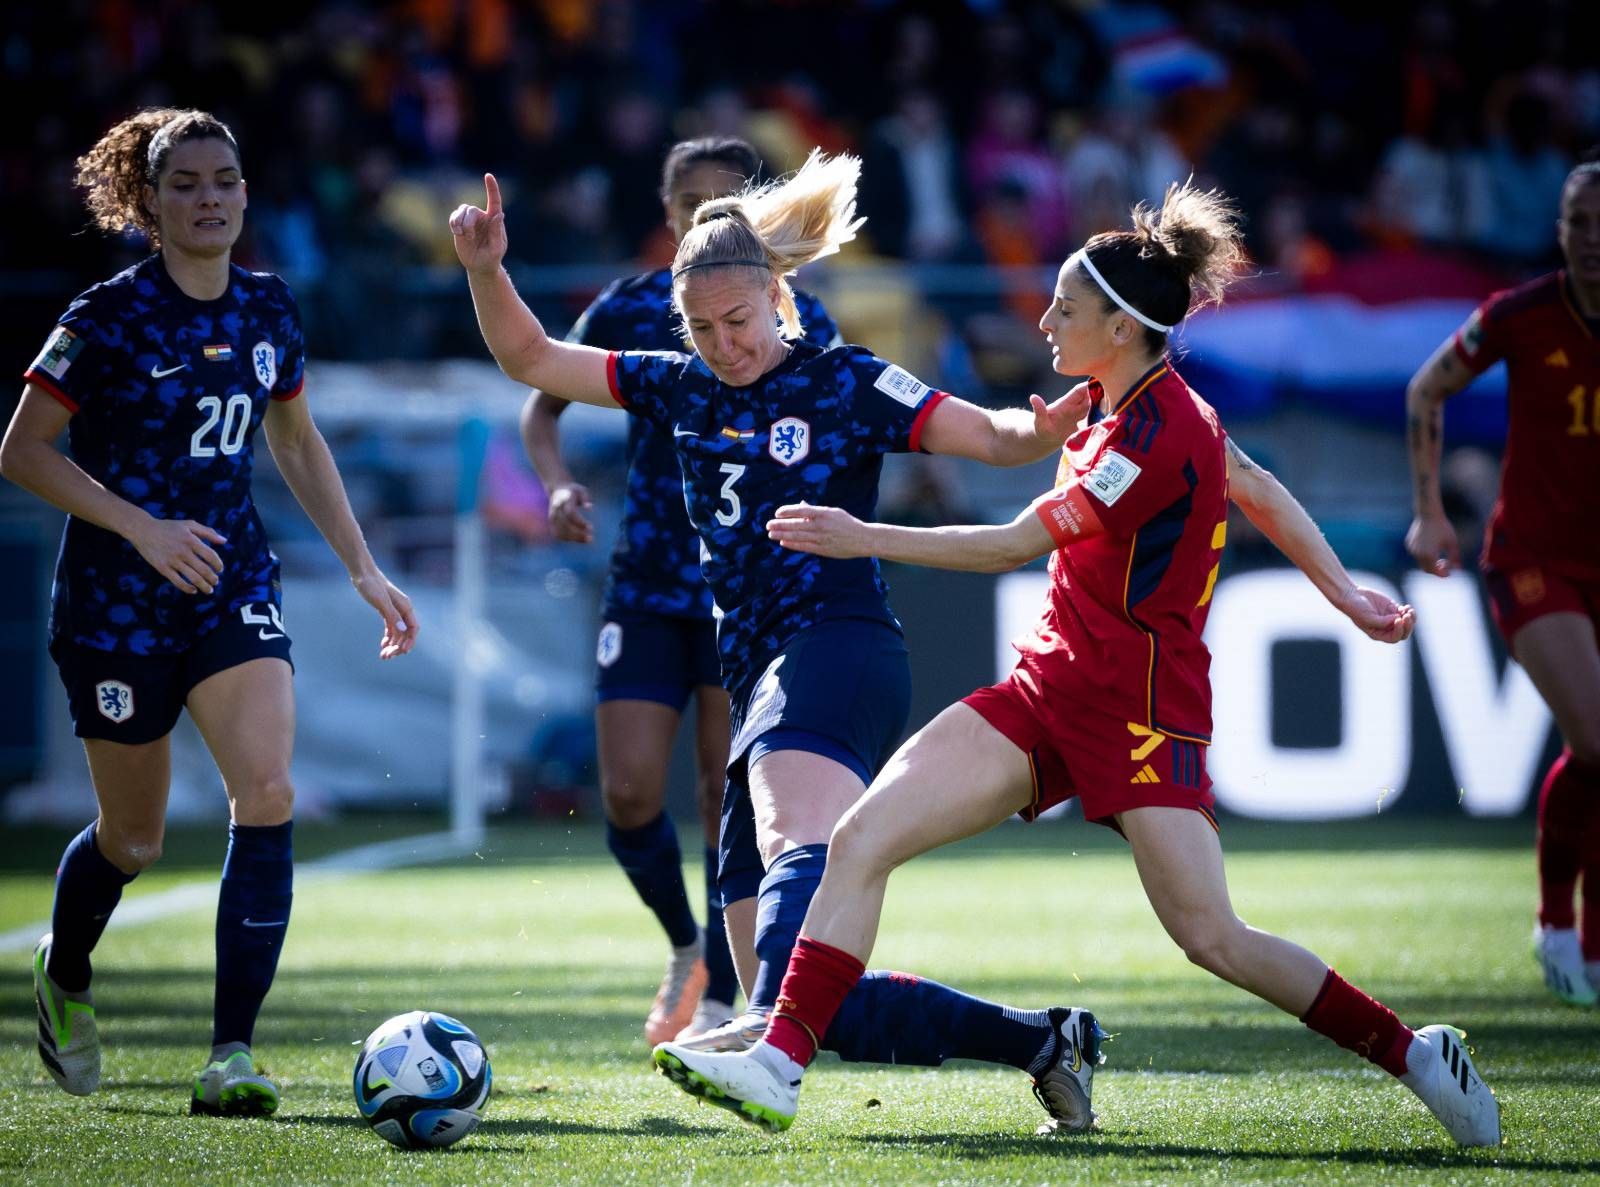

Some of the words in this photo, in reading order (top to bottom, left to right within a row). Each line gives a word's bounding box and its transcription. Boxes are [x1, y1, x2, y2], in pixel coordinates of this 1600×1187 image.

[190, 394, 252, 457] 20
[715, 462, 746, 527] 3
[1050, 507, 1063, 521] FOR
[1056, 502, 1081, 535] EDUCATION
[1056, 518, 1068, 531] ALL
